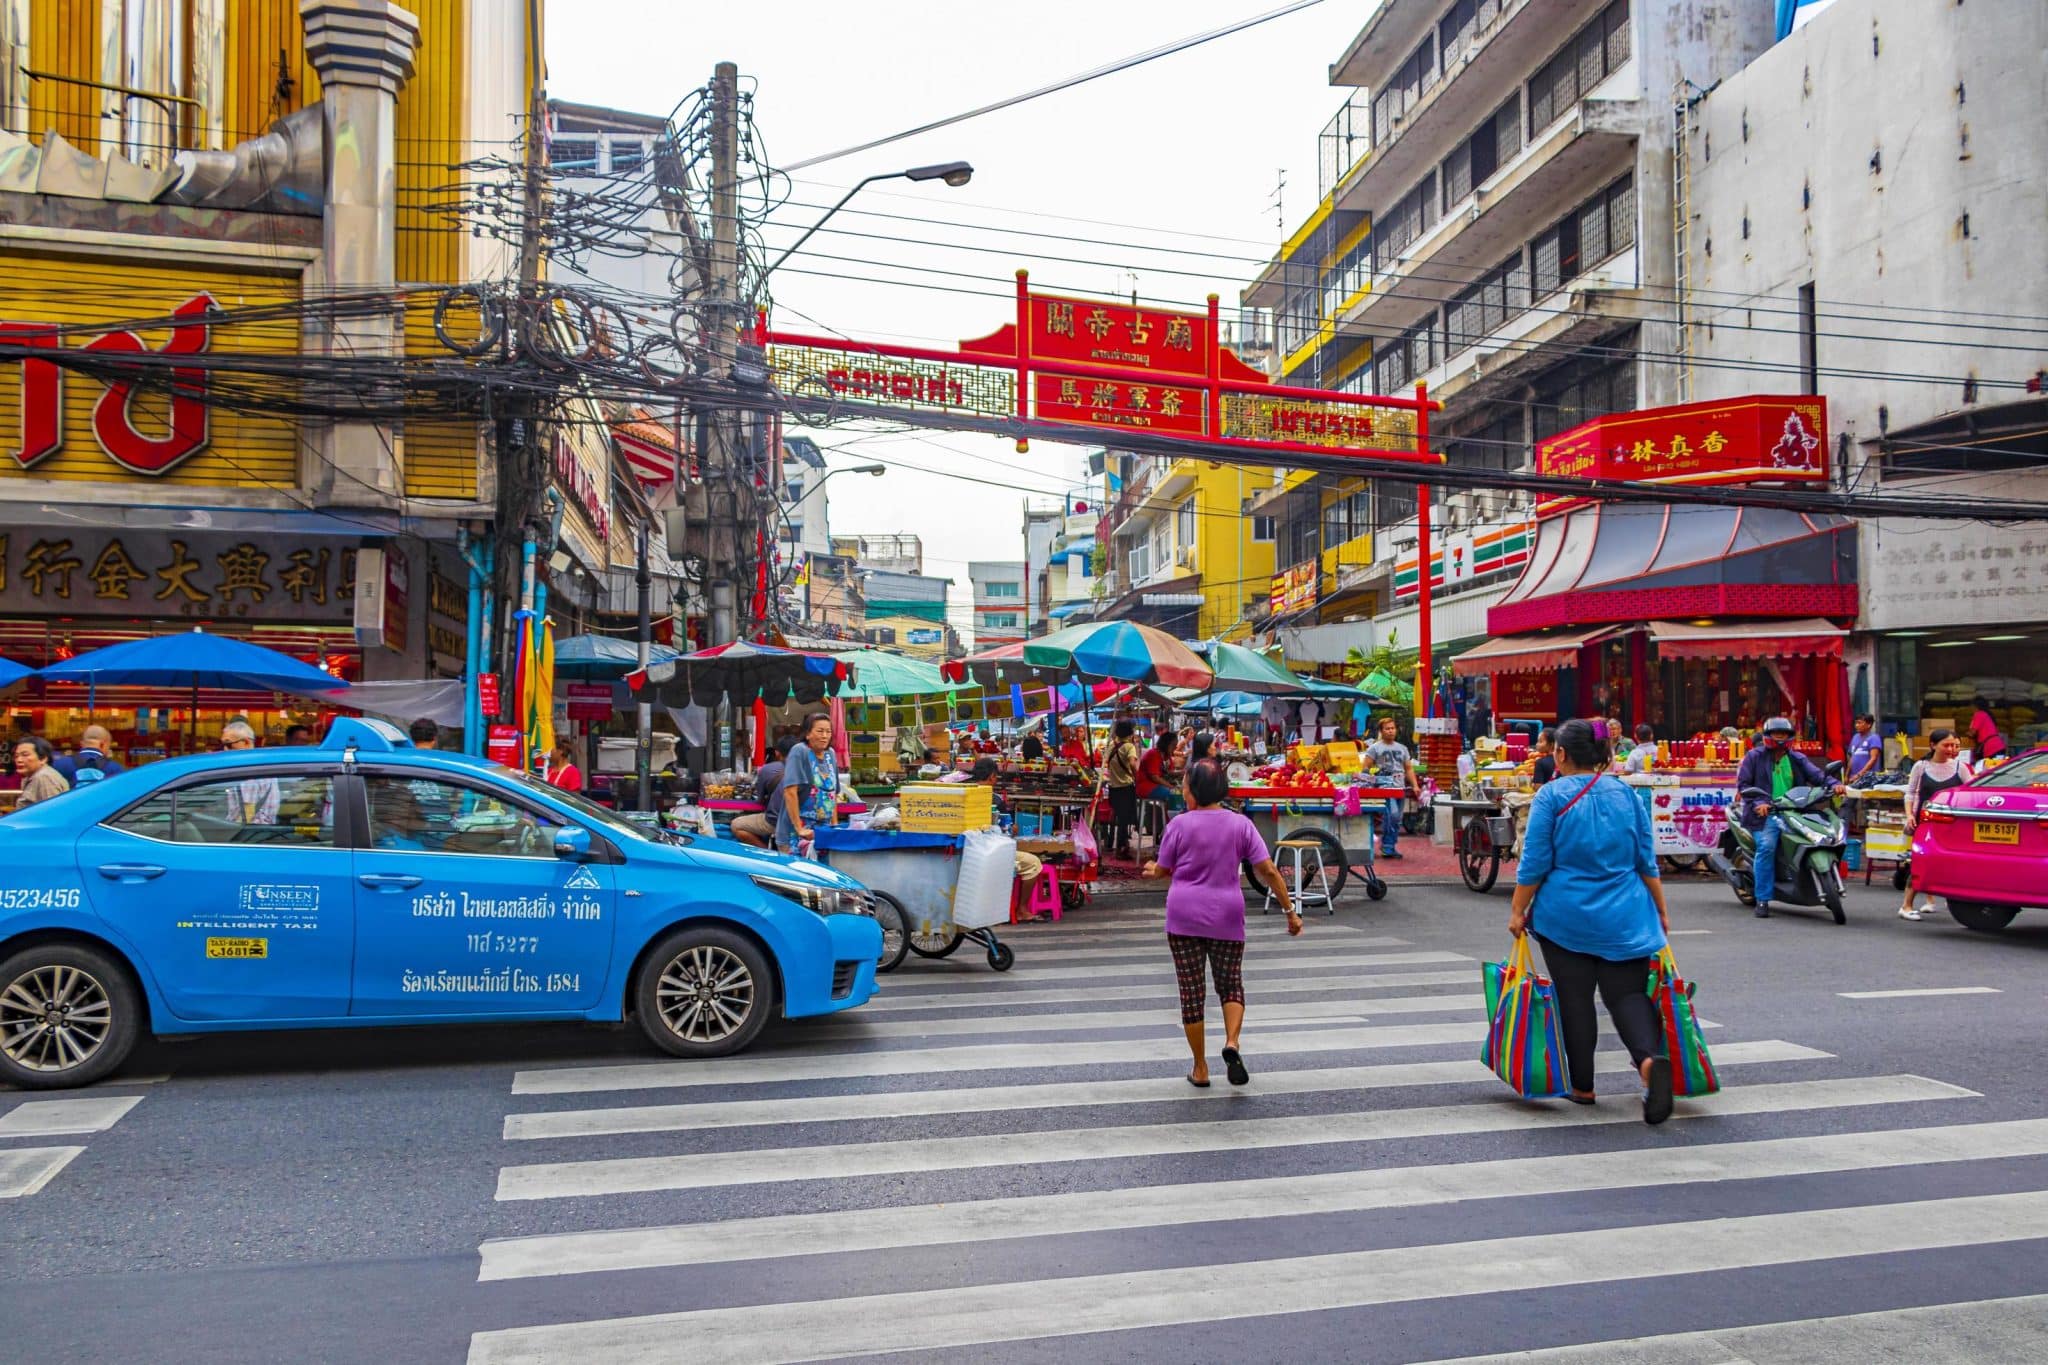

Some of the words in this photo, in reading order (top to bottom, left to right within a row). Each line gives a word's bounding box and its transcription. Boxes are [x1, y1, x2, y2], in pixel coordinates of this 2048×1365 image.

[1046, 303, 1193, 353] 關帝古廟
[1630, 430, 1729, 463] 林真香
[412, 890, 456, 918] บริษัท
[562, 894, 601, 921] จำกัด
[221, 947, 248, 956] 1681
[496, 935, 540, 953] 5277
[546, 973, 580, 992] 1584
